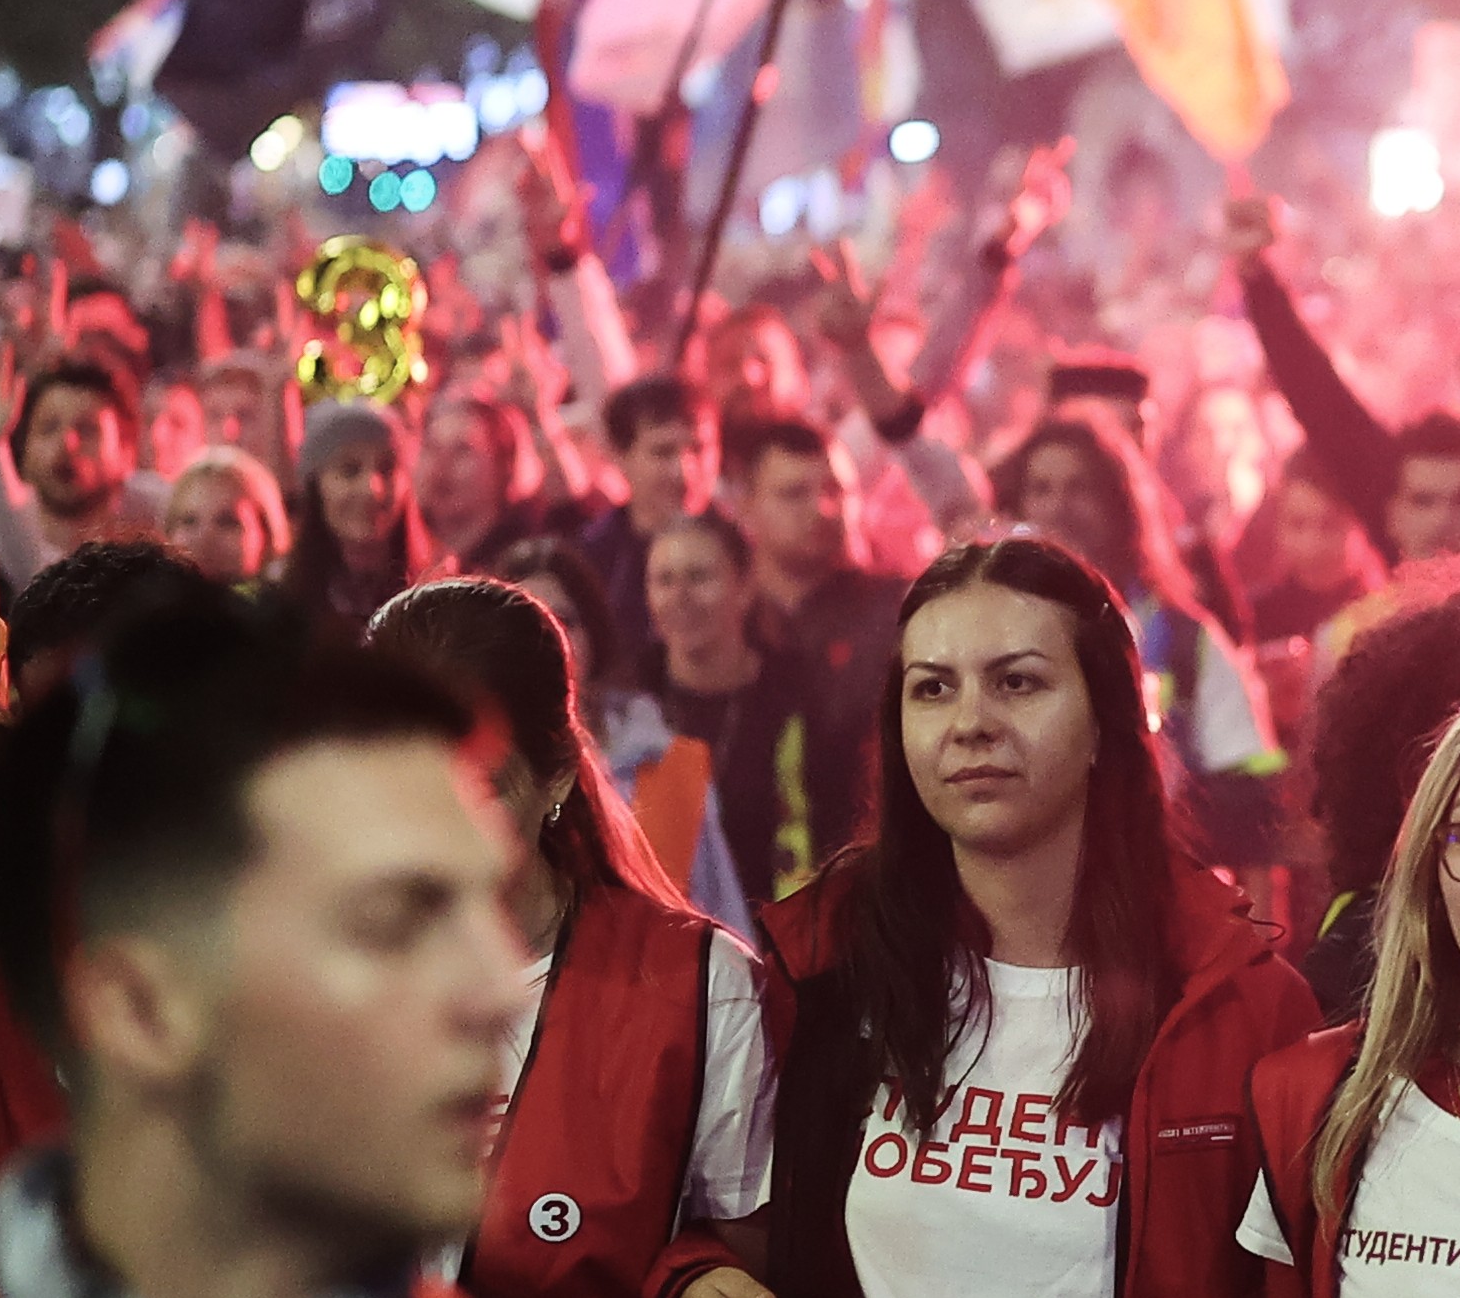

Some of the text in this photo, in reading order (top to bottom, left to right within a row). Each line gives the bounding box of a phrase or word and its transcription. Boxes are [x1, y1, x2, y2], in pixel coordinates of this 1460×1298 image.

[870, 1075, 1104, 1149] ТУДЕН
[864, 1131, 1123, 1208] ОБЕЂУЈ
[540, 1200, 570, 1237] 3
